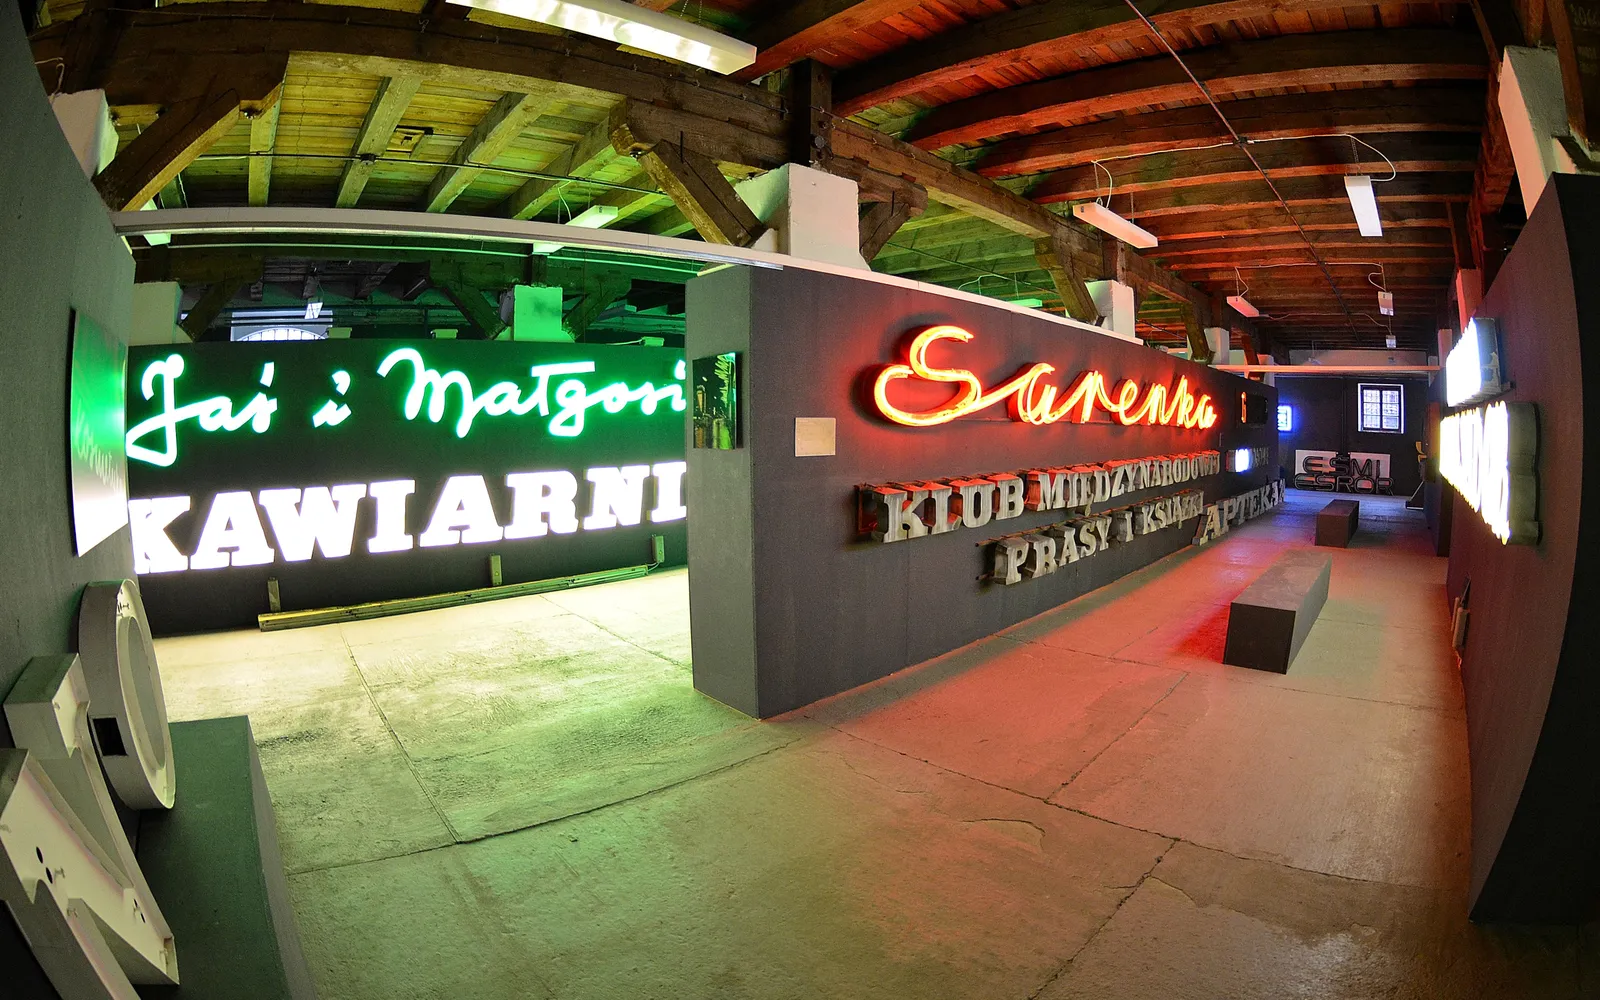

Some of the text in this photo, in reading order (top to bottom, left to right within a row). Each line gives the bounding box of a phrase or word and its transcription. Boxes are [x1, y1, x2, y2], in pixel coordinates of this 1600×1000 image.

[125, 353, 278, 467] Jaś
[312, 370, 352, 428] i
[873, 324, 1217, 430] Sarenka
[127, 460, 687, 575] KAWIARNI
[878, 476, 1025, 543] KLUB
[997, 514, 1112, 585] PRASY
[1117, 511, 1134, 543] I
